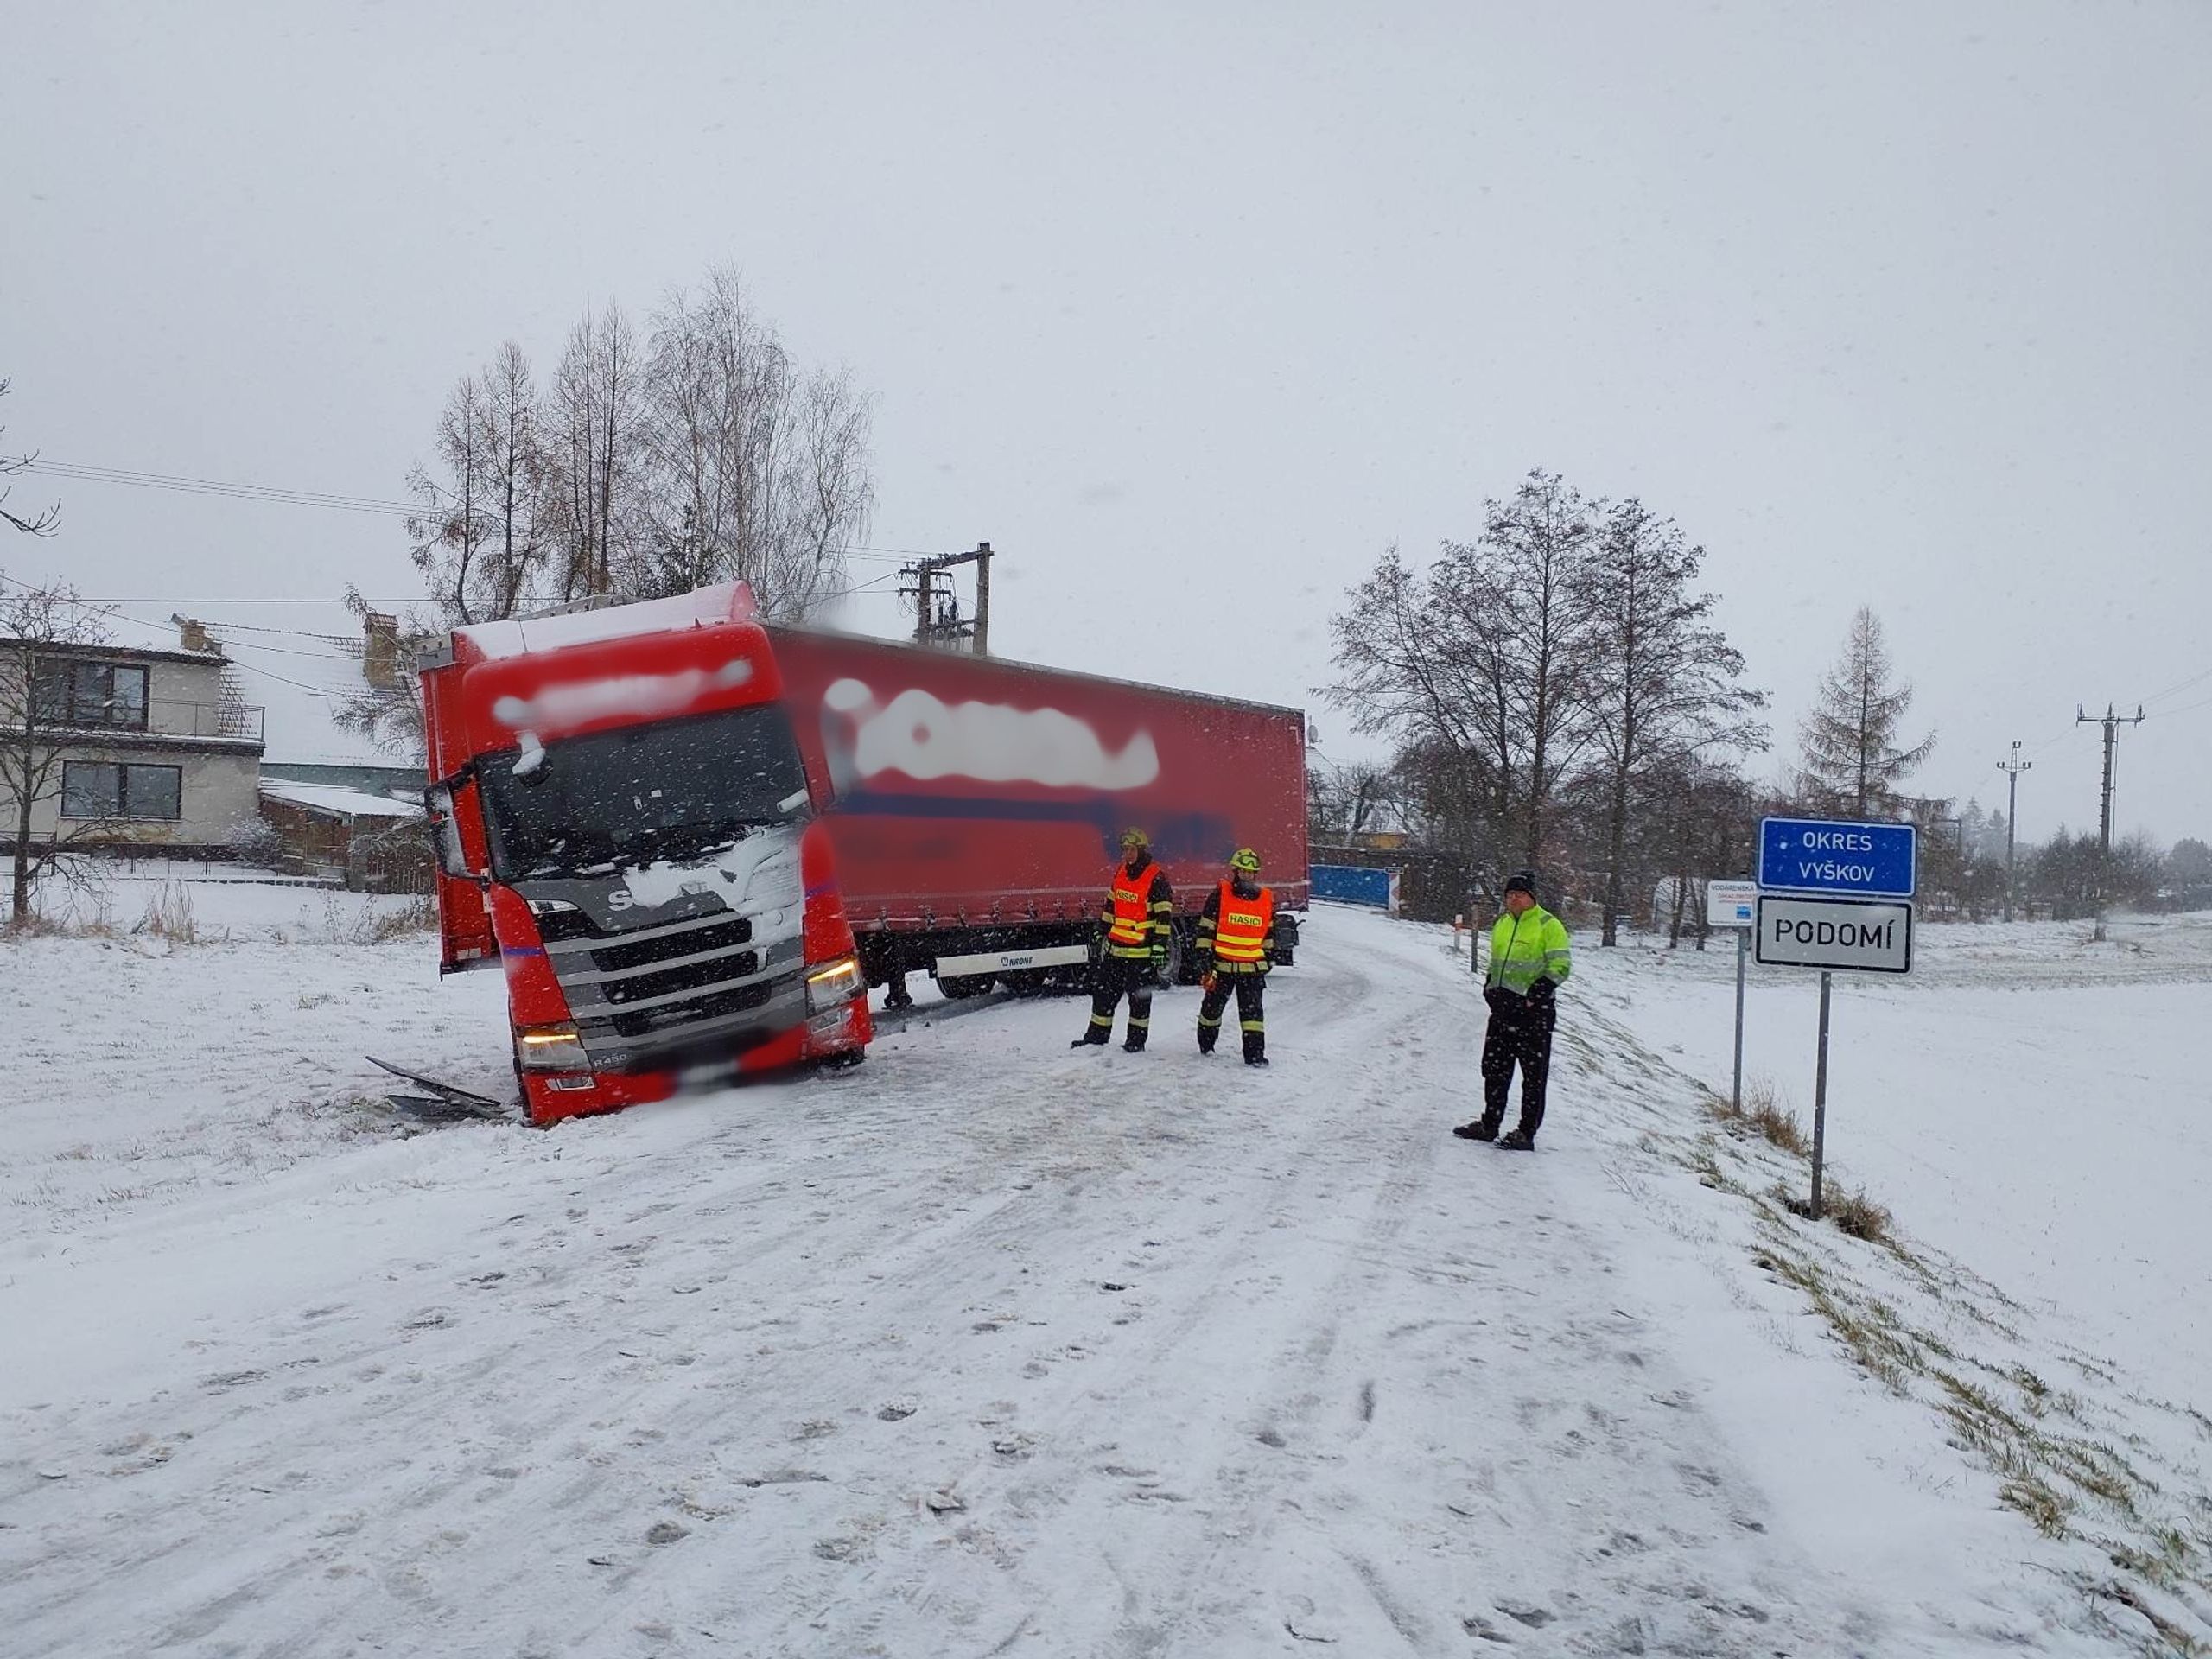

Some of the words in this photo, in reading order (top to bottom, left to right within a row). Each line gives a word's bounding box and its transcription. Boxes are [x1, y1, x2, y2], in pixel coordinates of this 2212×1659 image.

[1802, 831, 1872, 851] OKRES
[1799, 859, 1875, 882] VYŠKOV
[1775, 918, 1896, 949] PODOMÍ
[1009, 957, 1033, 966] KRONE
